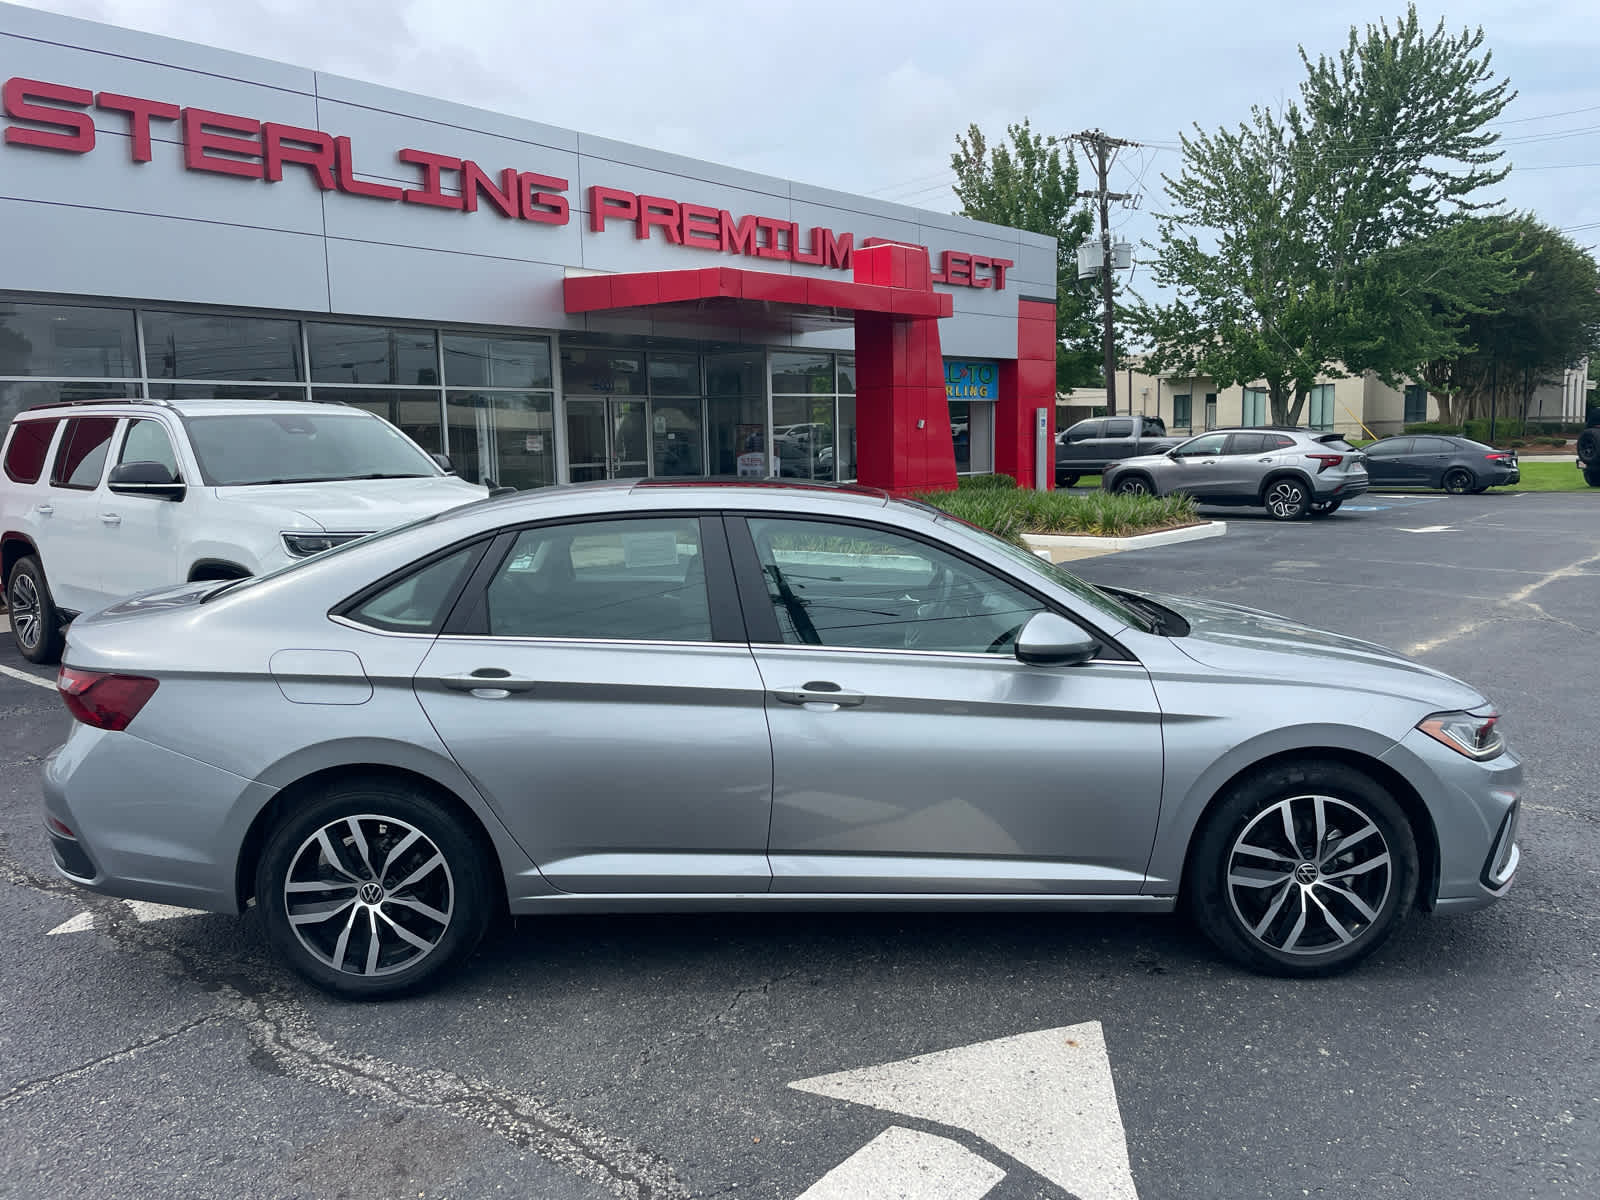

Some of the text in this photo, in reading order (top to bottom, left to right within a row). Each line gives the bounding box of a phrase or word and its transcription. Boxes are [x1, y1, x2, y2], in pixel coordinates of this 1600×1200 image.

[3, 76, 1014, 290] STERLING PREMIUM LECT
[360, 882, 383, 905] VW
